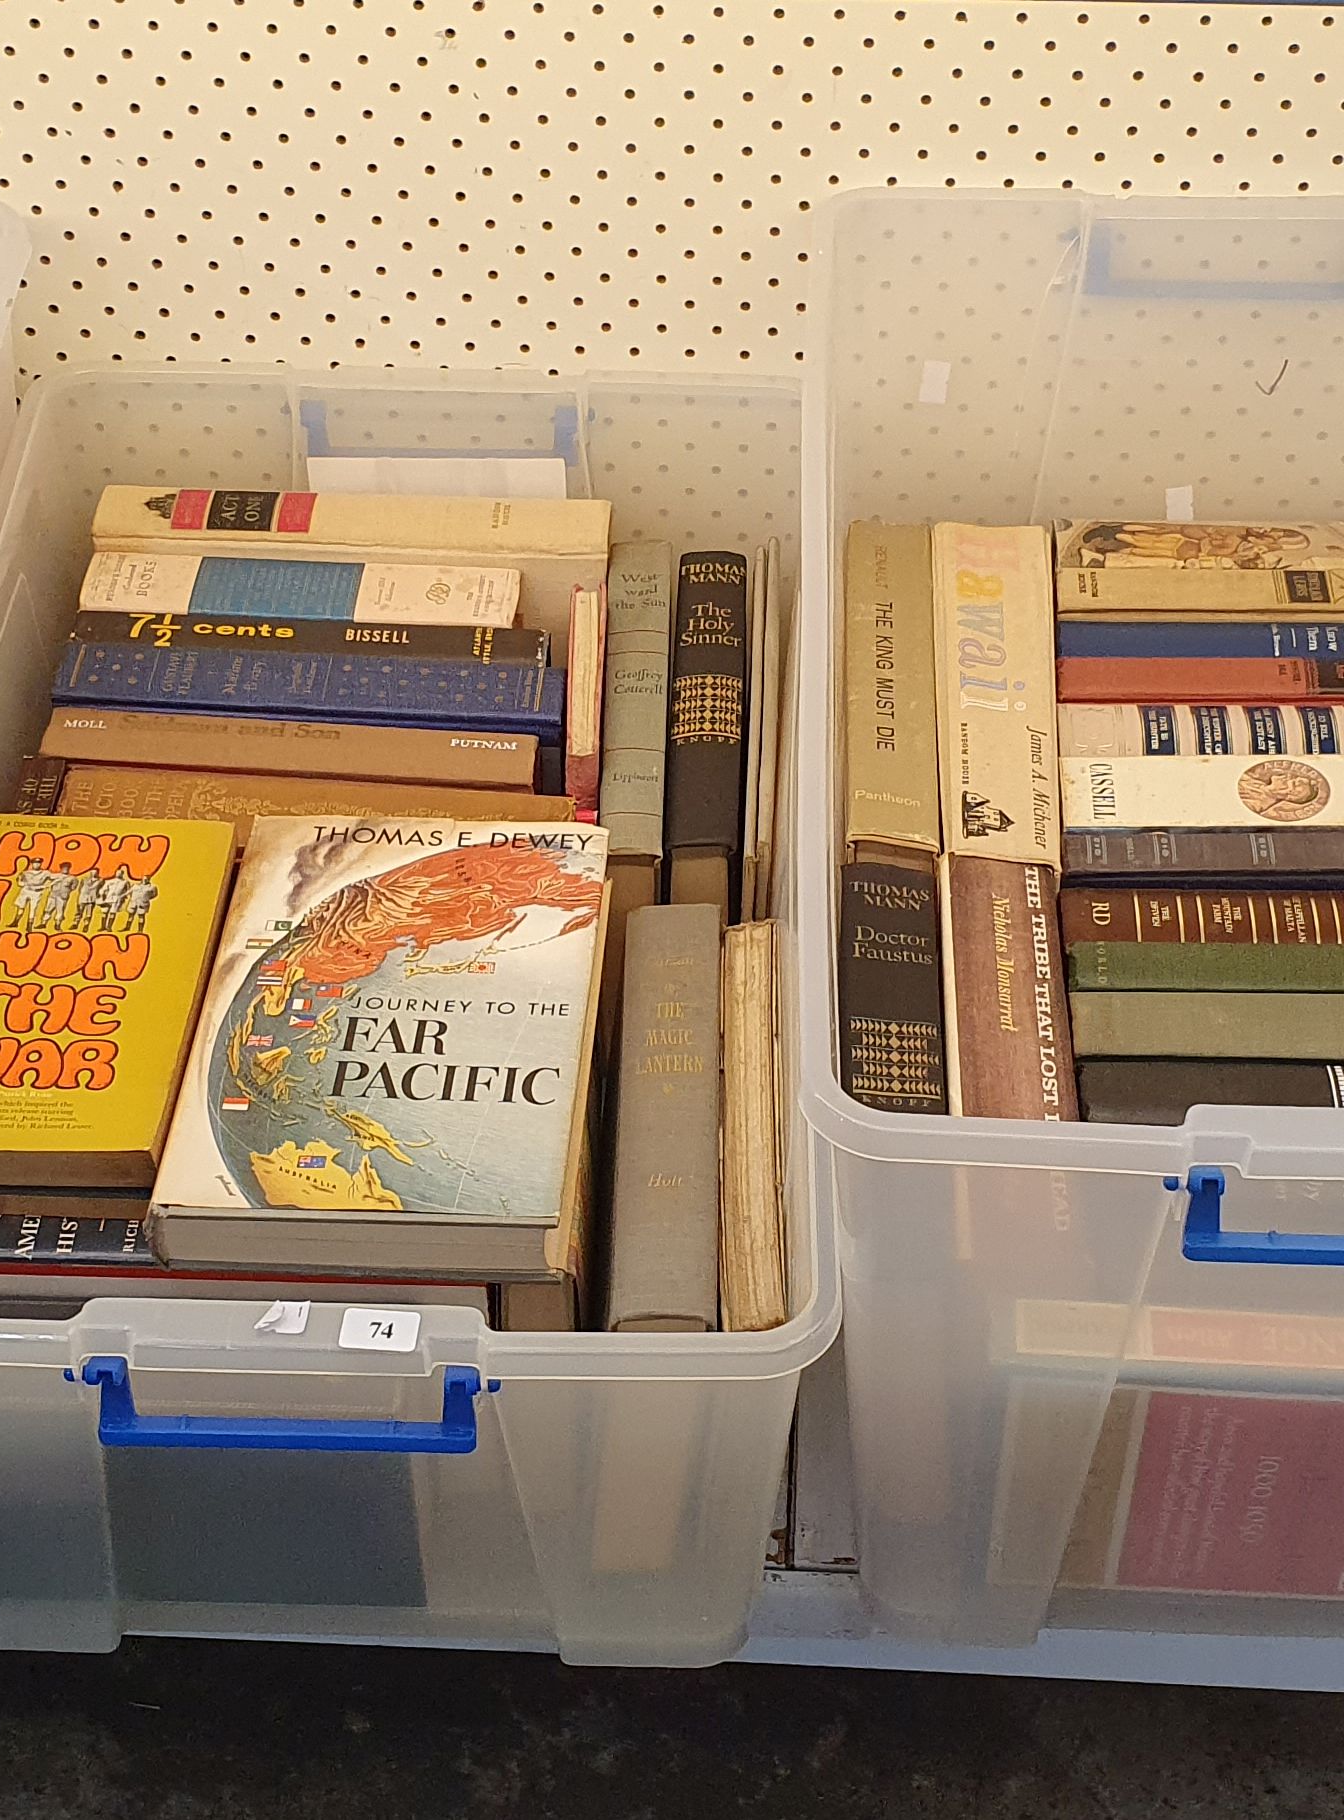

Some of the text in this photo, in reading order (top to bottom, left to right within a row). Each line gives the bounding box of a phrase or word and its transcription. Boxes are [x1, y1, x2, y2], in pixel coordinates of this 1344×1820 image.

[221, 494, 240, 523] ACT
[244, 495, 262, 523] ONE
[137, 560, 157, 598] BOOKS
[680, 562, 747, 577] THOMAS
[688, 573, 742, 585] MANN
[614, 598, 667, 610] the Sun
[691, 603, 733, 618] The
[193, 622, 410, 645] cents BISSELL
[686, 618, 735, 635] Holy
[956, 535, 1028, 713] Hawaii
[679, 632, 743, 648] Sinner
[1306, 627, 1318, 651] Them
[1325, 626, 1339, 652] Know
[614, 668, 664, 682] Geoffrey
[875, 602, 896, 752] THE KING MUST DIE
[613, 683, 664, 695] Cotterell
[63, 718, 107, 731] MOLL
[238, 719, 285, 737] and
[291, 721, 341, 741] Son
[450, 737, 519, 752] PUTNAM
[676, 736, 738, 746] KNOPF
[72, 781, 94, 812] THE
[854, 788, 922, 808] Pantheon
[1026, 724, 1051, 850] James A. Michener
[1088, 763, 1116, 820] CASSELL
[313, 825, 594, 852] THOMAS E. DEWEY
[849, 880, 930, 901] THOMAS
[863, 894, 924, 911] MANN
[1091, 901, 1111, 926] RD
[1233, 906, 1243, 921] THE
[855, 925, 930, 948] Doctor
[852, 941, 934, 966] Faustus
[991, 892, 1018, 1032] Nicholas Monsarrat
[1023, 865, 1059, 1113] THE TRIBE THAT LOST
[350, 996, 571, 1017] JOURNEY TO THE
[655, 1002, 687, 1020] THE
[339, 1015, 449, 1056] FAR
[645, 1029, 695, 1047] MAGIC
[635, 1056, 705, 1076] LANTERN
[326, 1059, 561, 1106] PACIFIC
[859, 1093, 933, 1107] KNOPF
[647, 1172, 686, 1189] Holt
[369, 1321, 395, 1339] 74
